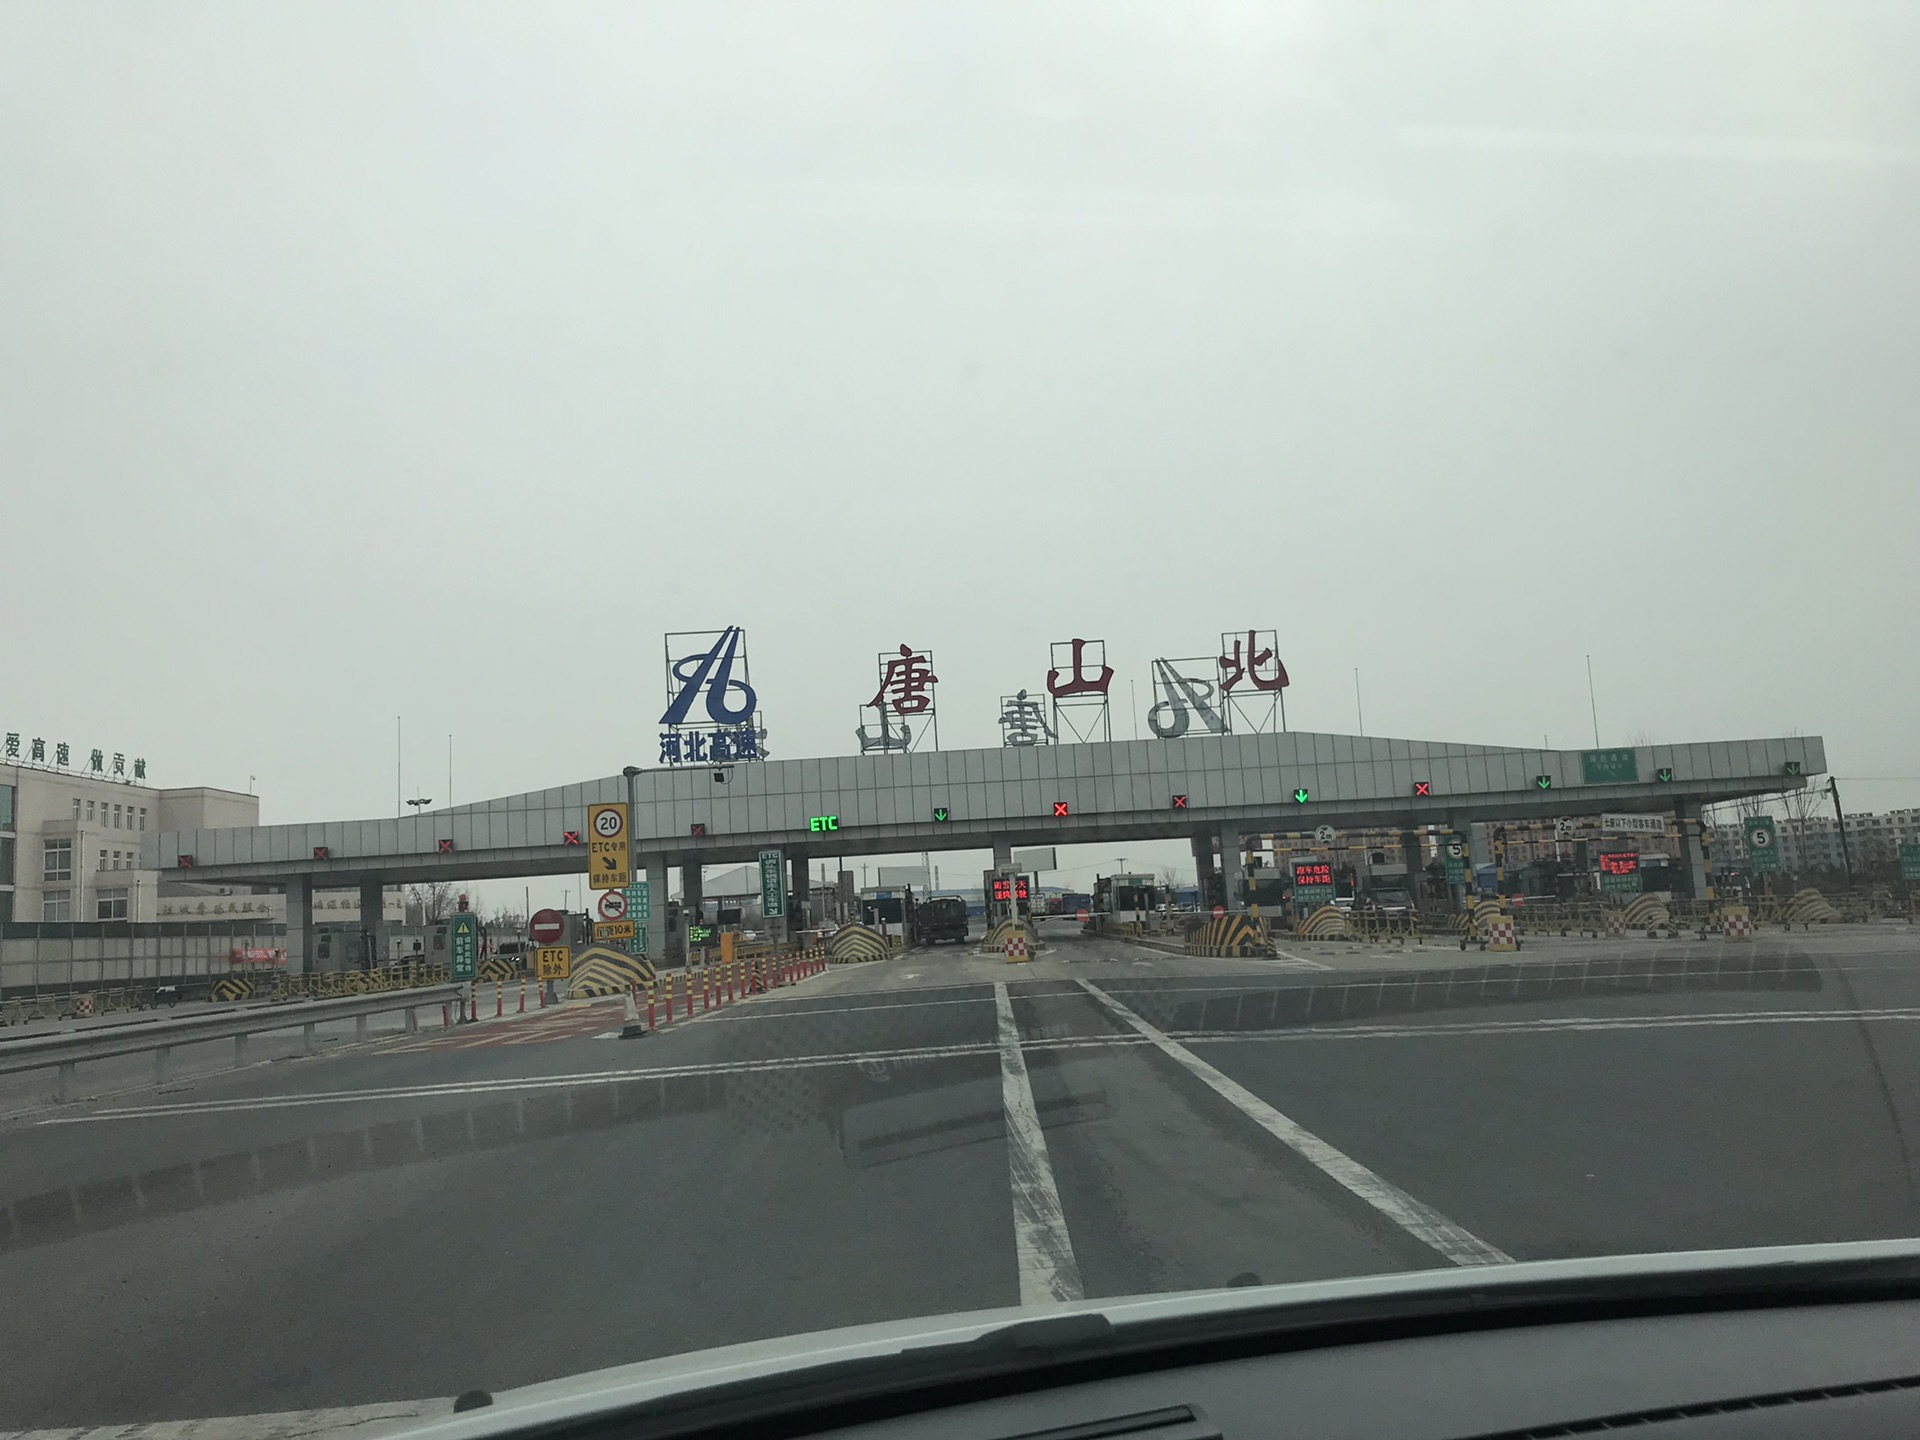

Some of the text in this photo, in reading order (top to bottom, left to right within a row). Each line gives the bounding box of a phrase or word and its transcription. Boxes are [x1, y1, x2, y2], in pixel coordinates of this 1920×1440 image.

[659, 729, 757, 763] 河北高速
[600, 816, 617, 830] 20
[810, 815, 838, 831] ETC
[1560, 821, 1571, 831] 2m
[1320, 830, 1332, 840] 2m
[1757, 832, 1766, 844] 5
[1452, 843, 1461, 855] 5
[593, 872, 627, 885] 保持车距
[542, 950, 563, 963] ETC
[542, 963, 563, 976] 除外
